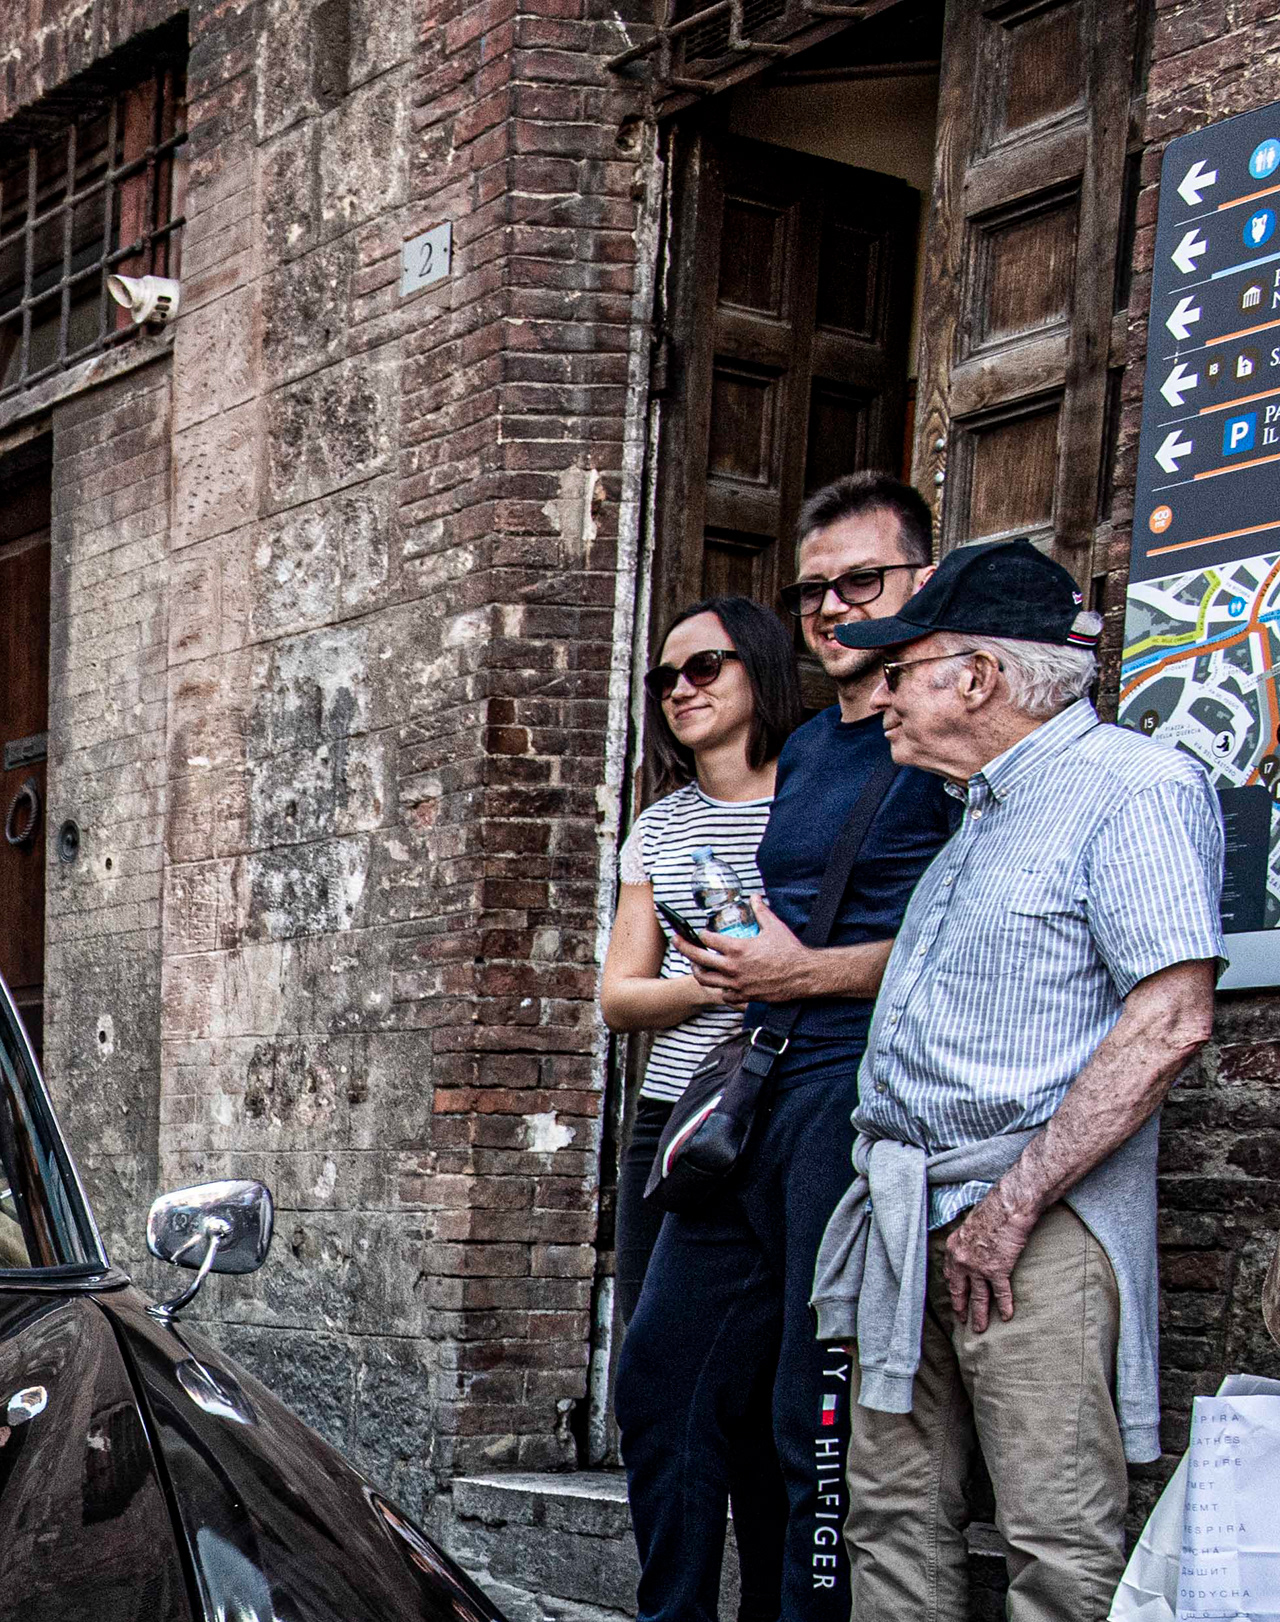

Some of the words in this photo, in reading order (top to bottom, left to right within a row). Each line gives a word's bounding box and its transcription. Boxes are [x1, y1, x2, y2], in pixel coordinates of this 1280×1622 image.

[418, 242, 433, 278] 2
[1229, 420, 1249, 449] P
[1143, 718, 1154, 728] 15
[1264, 763, 1274, 774] 17
[812, 1437, 840, 1589] HILFIGER
[1180, 1588, 1250, 1599] ODDYCHA
